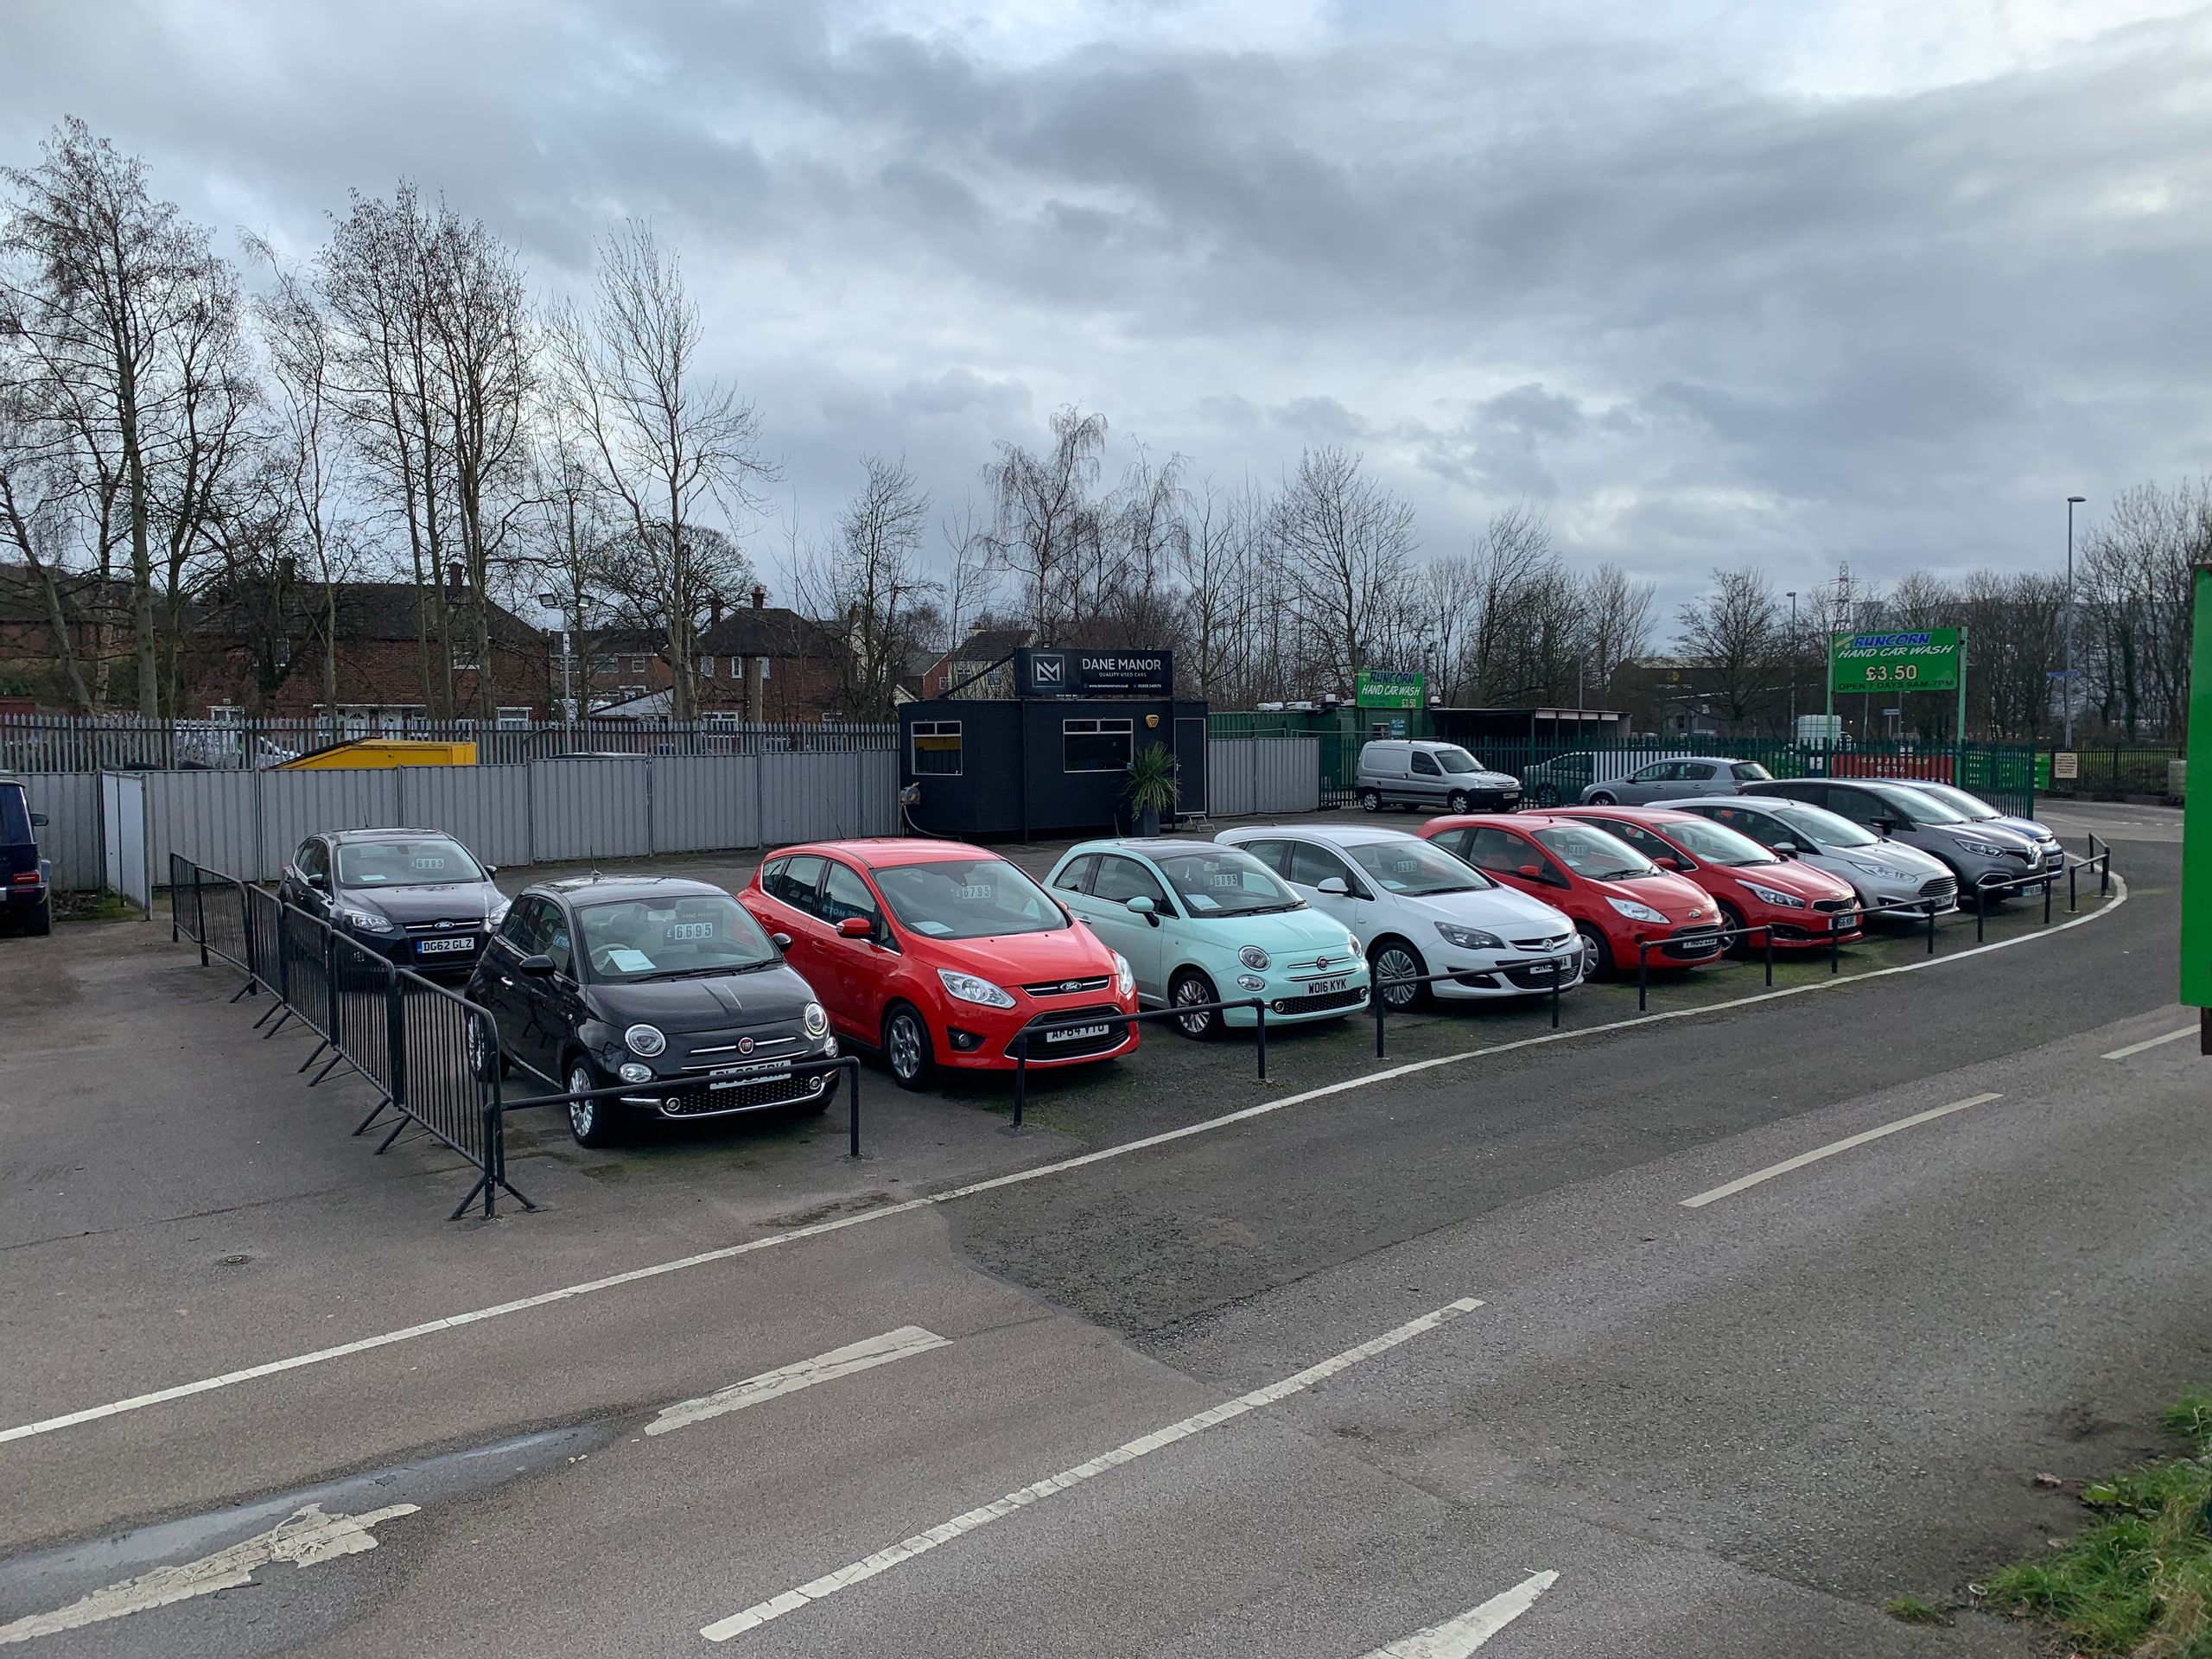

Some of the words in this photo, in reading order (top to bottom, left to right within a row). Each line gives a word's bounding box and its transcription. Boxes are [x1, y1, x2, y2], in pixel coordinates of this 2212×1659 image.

[1853, 633, 1932, 647] RUNCORN
[1838, 648, 1877, 658] HAND
[1880, 647, 1906, 657] CAR
[1910, 645, 1955, 655] WASH
[1082, 658, 1116, 670] DANE
[1118, 658, 1161, 671] MANOR
[1371, 671, 1415, 684] RUNCORN
[1866, 664, 1917, 682] £3.50
[1362, 685, 1383, 695] HAND
[1384, 685, 1399, 695] CAR
[1399, 686, 1421, 696] WASH
[1877, 680, 1904, 689] DAYS
[1906, 679, 1954, 688] 9AM-7PM
[423, 941, 449, 951] DG62
[453, 938, 472, 950] GLZ
[1308, 981, 1328, 995] WO16
[1330, 978, 1346, 991] KYK
